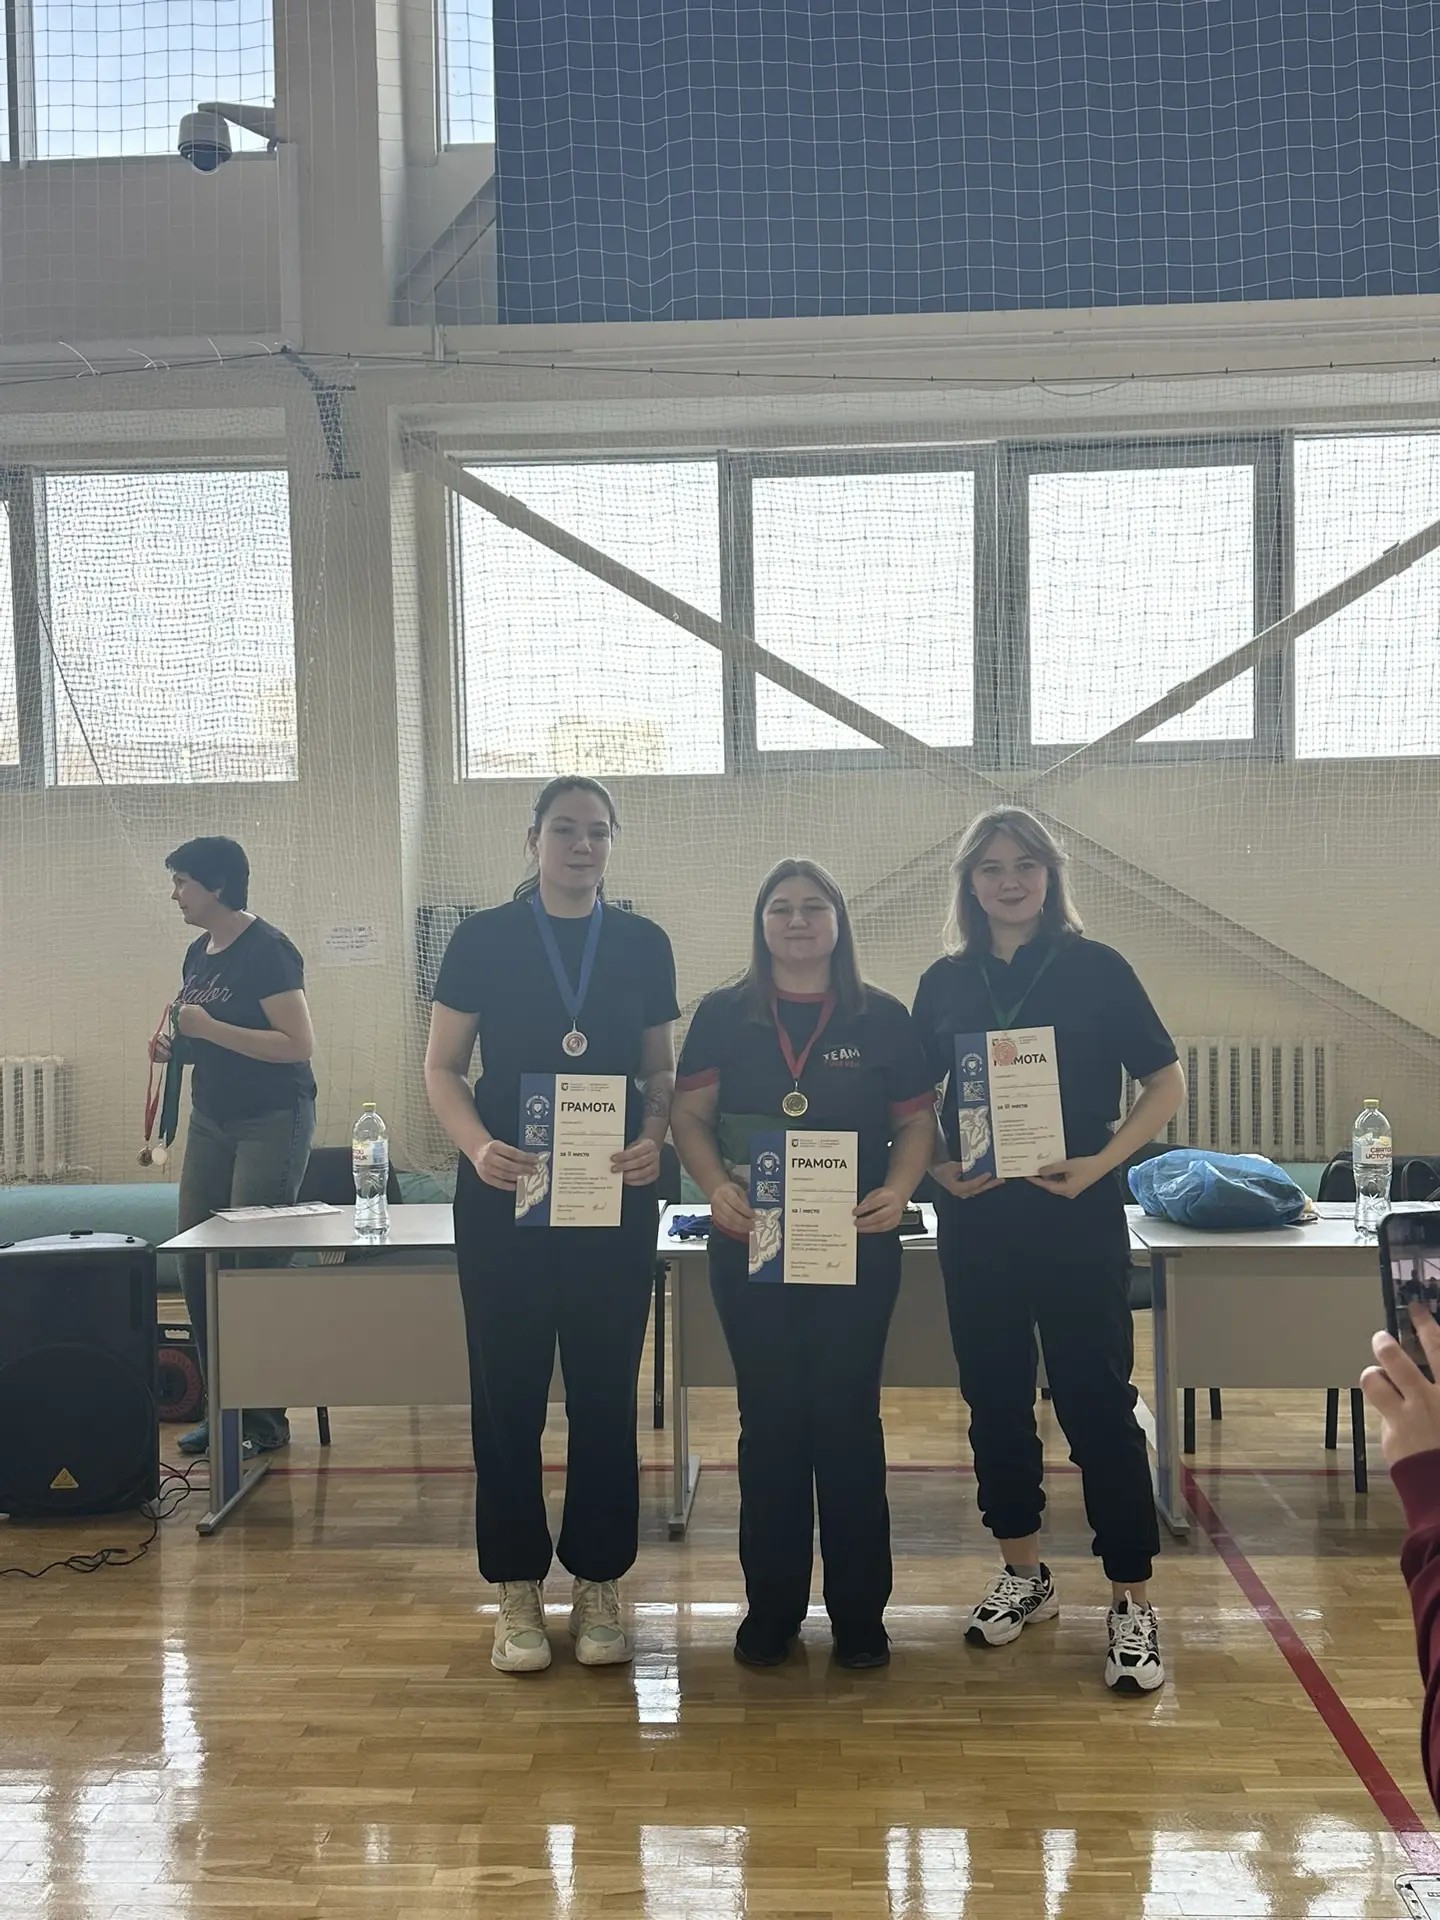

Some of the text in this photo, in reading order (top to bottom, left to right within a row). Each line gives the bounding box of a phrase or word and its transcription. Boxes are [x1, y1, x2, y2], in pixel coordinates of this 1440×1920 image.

[822, 1048, 861, 1060] TEAM
[993, 1052, 1047, 1067] МОТА
[561, 1101, 616, 1113] ГРАМОТА
[791, 1157, 848, 1169] ГРАМОТА
